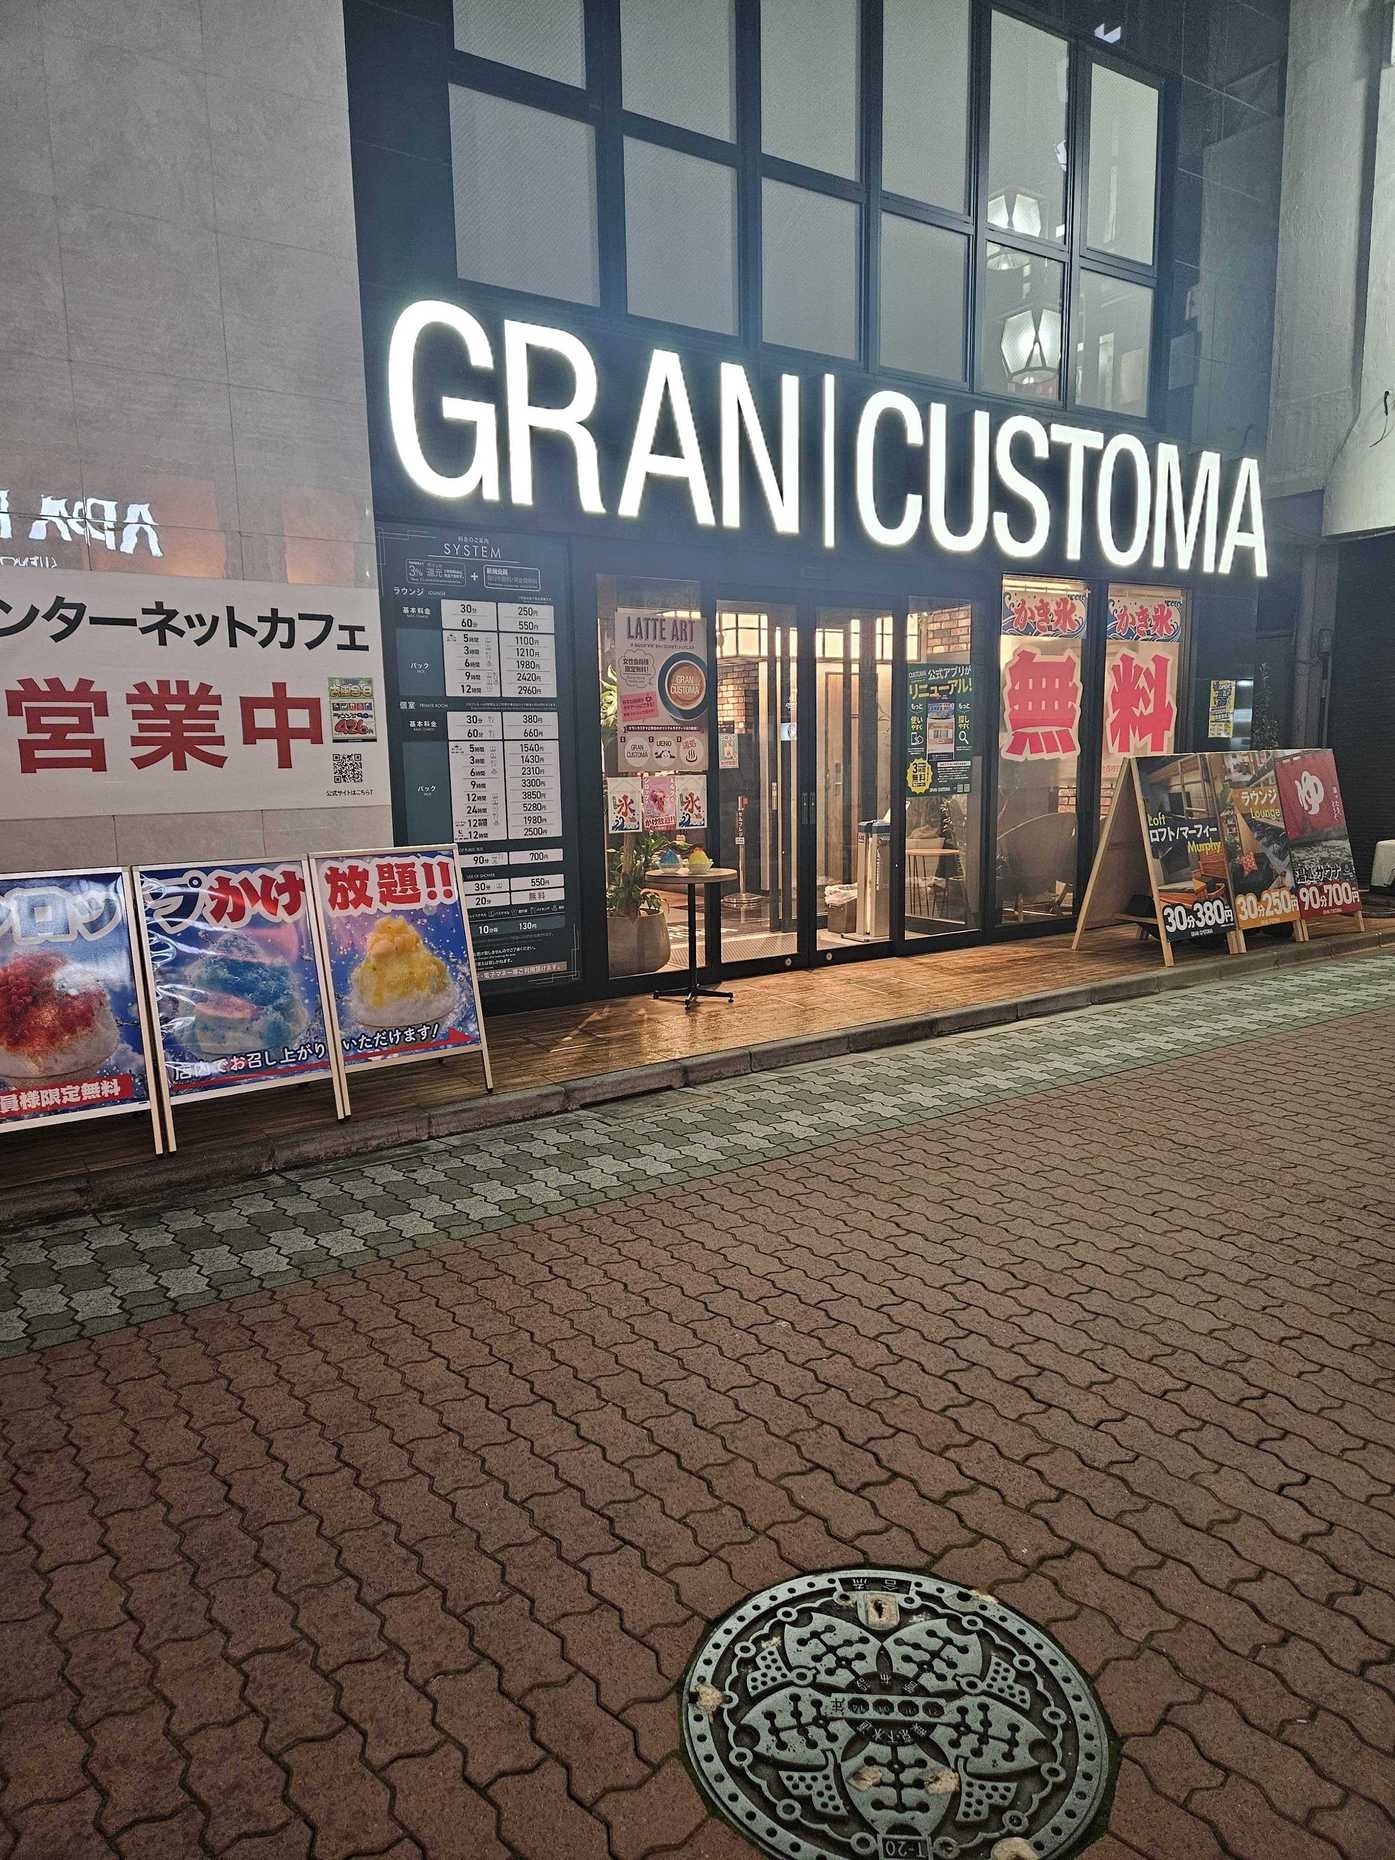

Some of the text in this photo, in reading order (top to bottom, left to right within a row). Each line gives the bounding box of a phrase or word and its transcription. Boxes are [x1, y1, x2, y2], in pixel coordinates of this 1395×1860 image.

[388, 299, 1269, 578] GRAN CUSTOMA
[443, 543, 501, 558] SYSTEM
[393, 586, 424, 596] ラウンジ
[518, 606, 538, 616] 250円
[1012, 597, 1079, 634] かき氷
[0, 595, 369, 652] ンターネットカフェ
[1116, 602, 1174, 638] かき氷
[519, 621, 539, 630] 550円
[627, 616, 696, 643] LATTE ART
[516, 636, 540, 646] 1100円
[516, 648, 540, 658] 1210円
[516, 660, 540, 670] 1980円
[517, 672, 542, 682] 2420円
[676, 676, 696, 684] GRAN
[671, 685, 700, 695] CUSTOMA
[909, 680, 973, 699] リニューアル!
[522, 714, 543, 724] 380円
[5, 677, 323, 774] 営業中
[524, 728, 543, 738] 660円
[520, 743, 544, 752] 1540円
[521, 754, 545, 764] 1430円
[522, 766, 545, 776] 2310円
[522, 778, 546, 788] 3300円
[522, 791, 546, 800] 3850円
[1241, 790, 1277, 804] ラウンジ
[1295, 771, 1324, 815] ゆ
[523, 802, 546, 812] 5280円
[616, 794, 634, 816] 氷
[684, 792, 702, 812] 氷
[1250, 807, 1280, 820] Lounge
[524, 816, 547, 825] 1980円
[1148, 813, 1166, 826] Loft
[524, 828, 548, 837] 2500円
[1150, 823, 1218, 842] ロフト/マーフィー
[1188, 839, 1221, 855] Murphy
[529, 852, 548, 861] 700円
[530, 877, 550, 887] 550円
[154, 864, 304, 927] プかけ
[0, 893, 118, 937] ロッ
[519, 922, 537, 930] 130円
[175, 1043, 326, 1080] 店内でお召し上がり
[886, 1840, 926, 1858] T-20
